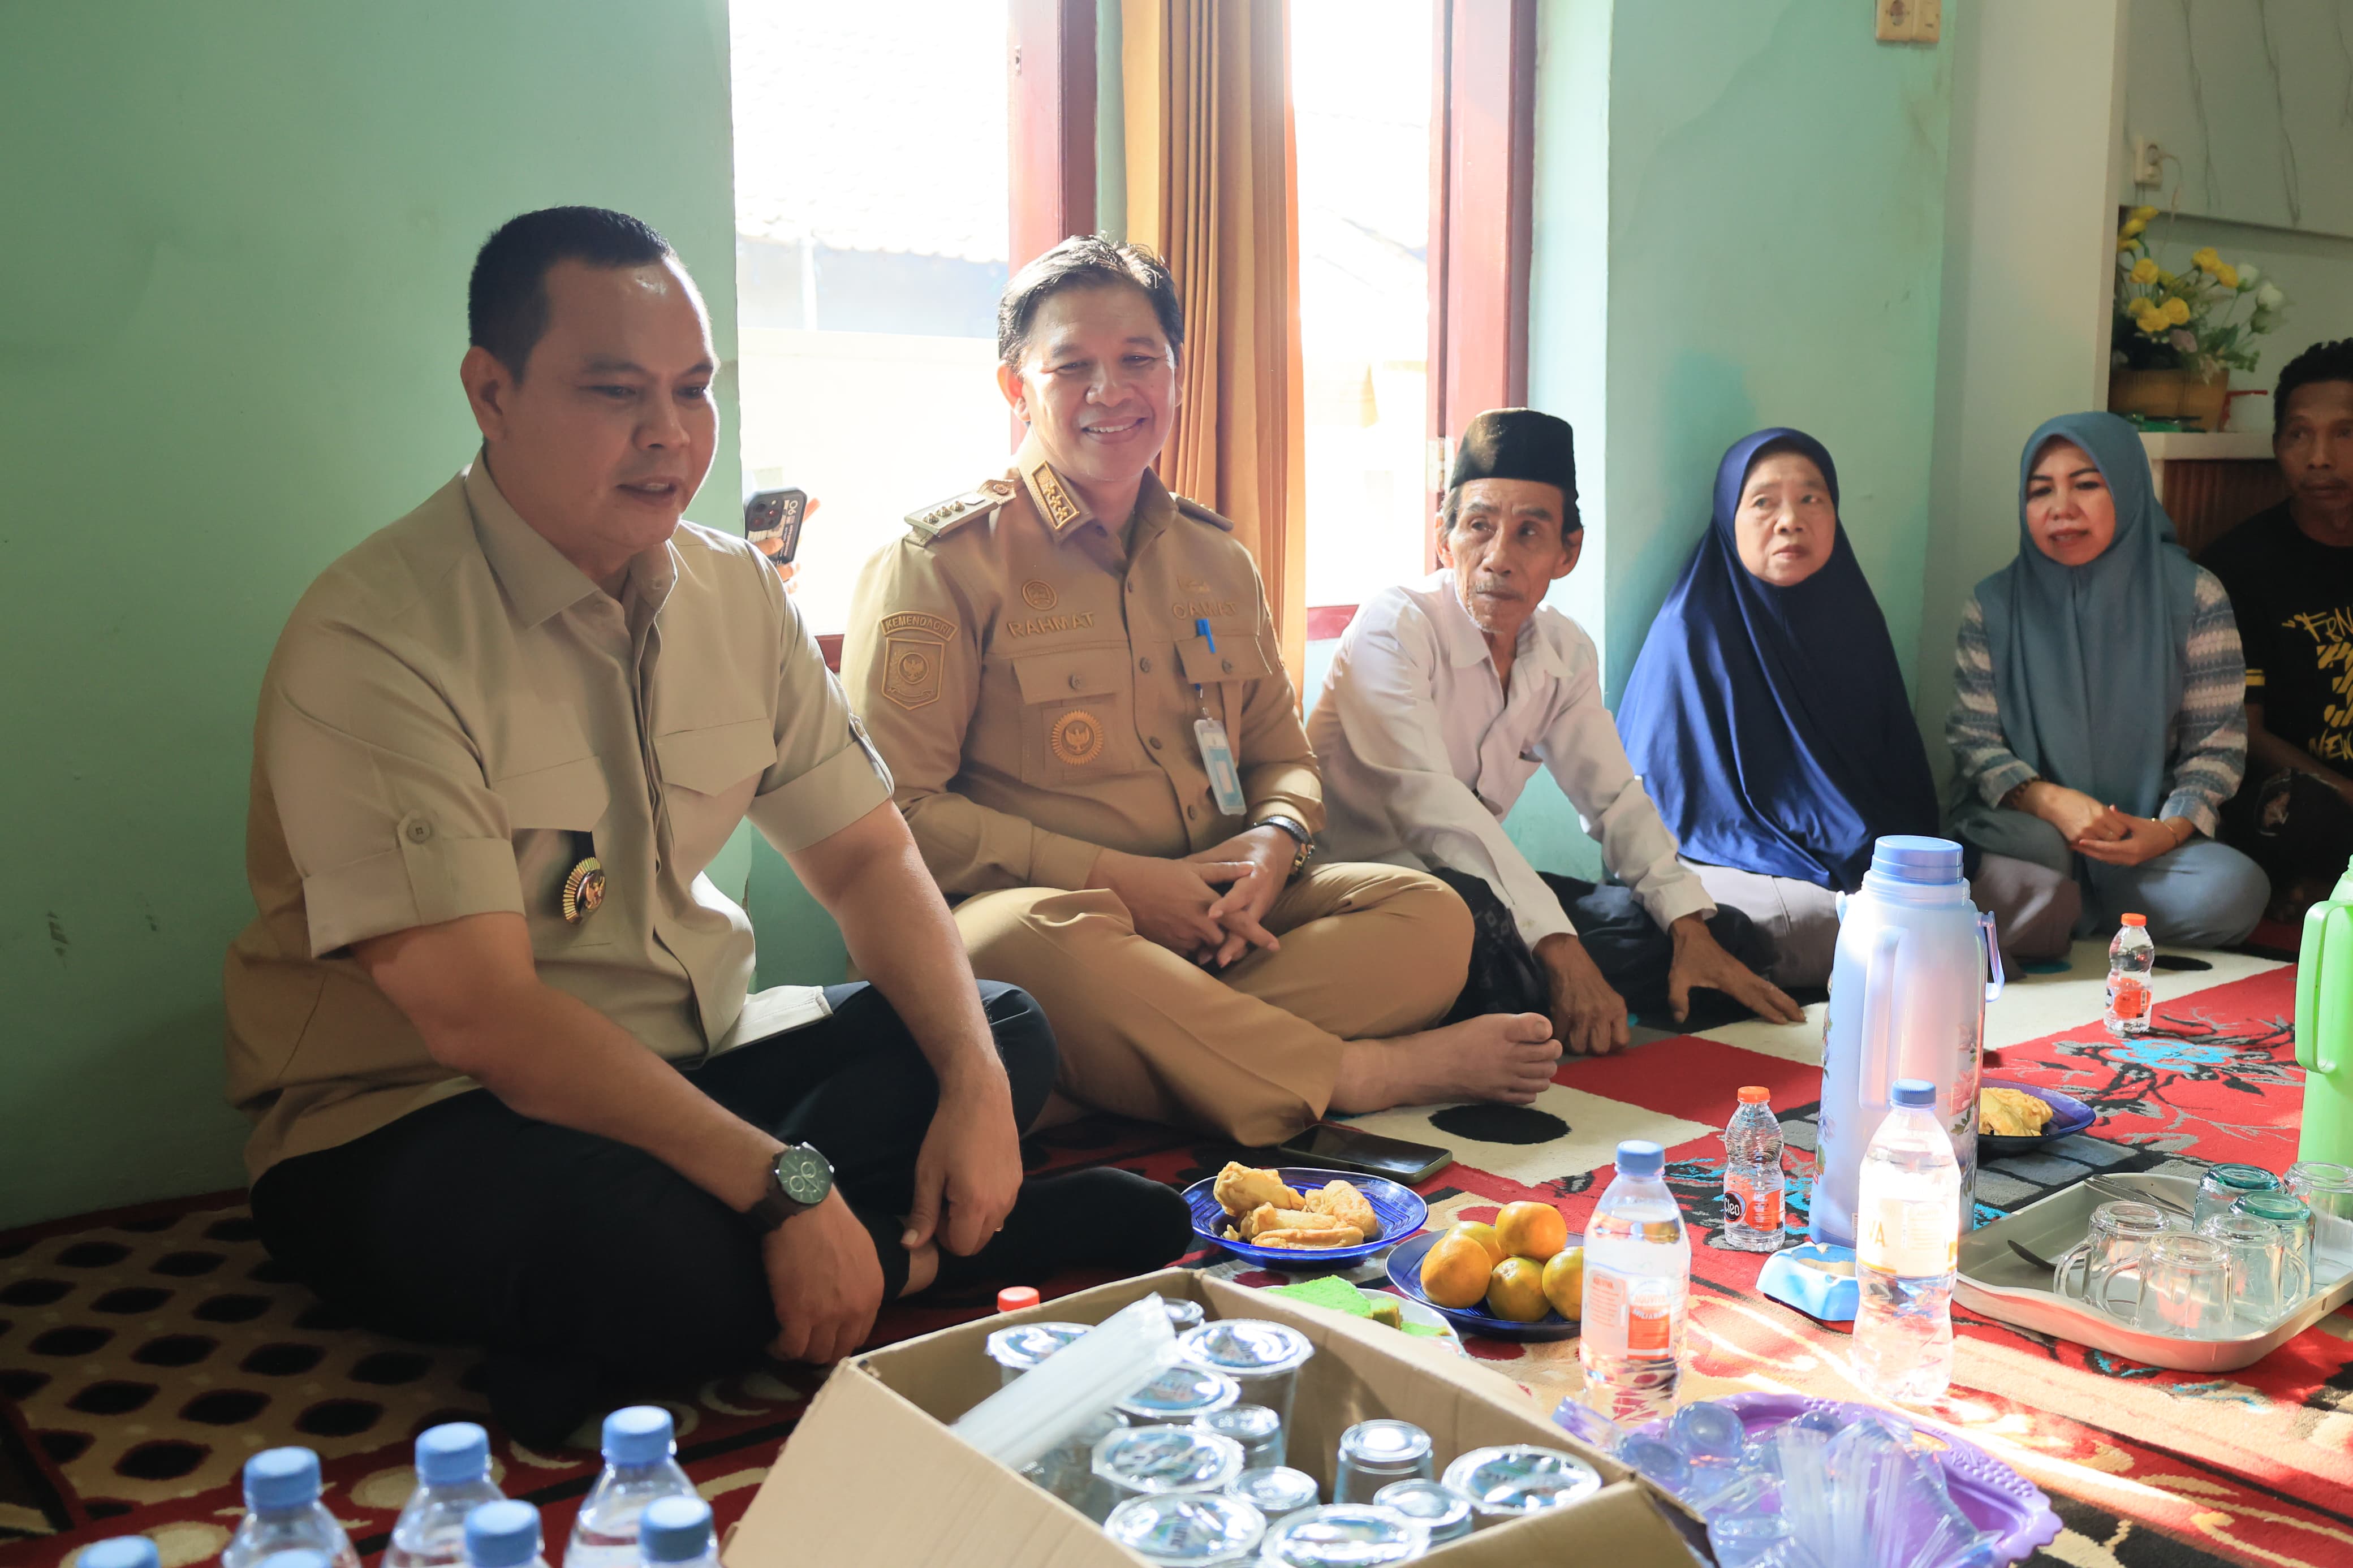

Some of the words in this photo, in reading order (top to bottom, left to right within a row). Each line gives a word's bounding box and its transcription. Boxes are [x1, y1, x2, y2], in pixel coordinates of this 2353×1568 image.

[886, 615, 951, 636] KEMENDAGRI
[1007, 611, 1094, 638] RAHMAT
[1724, 1198, 1740, 1217] Cleo
